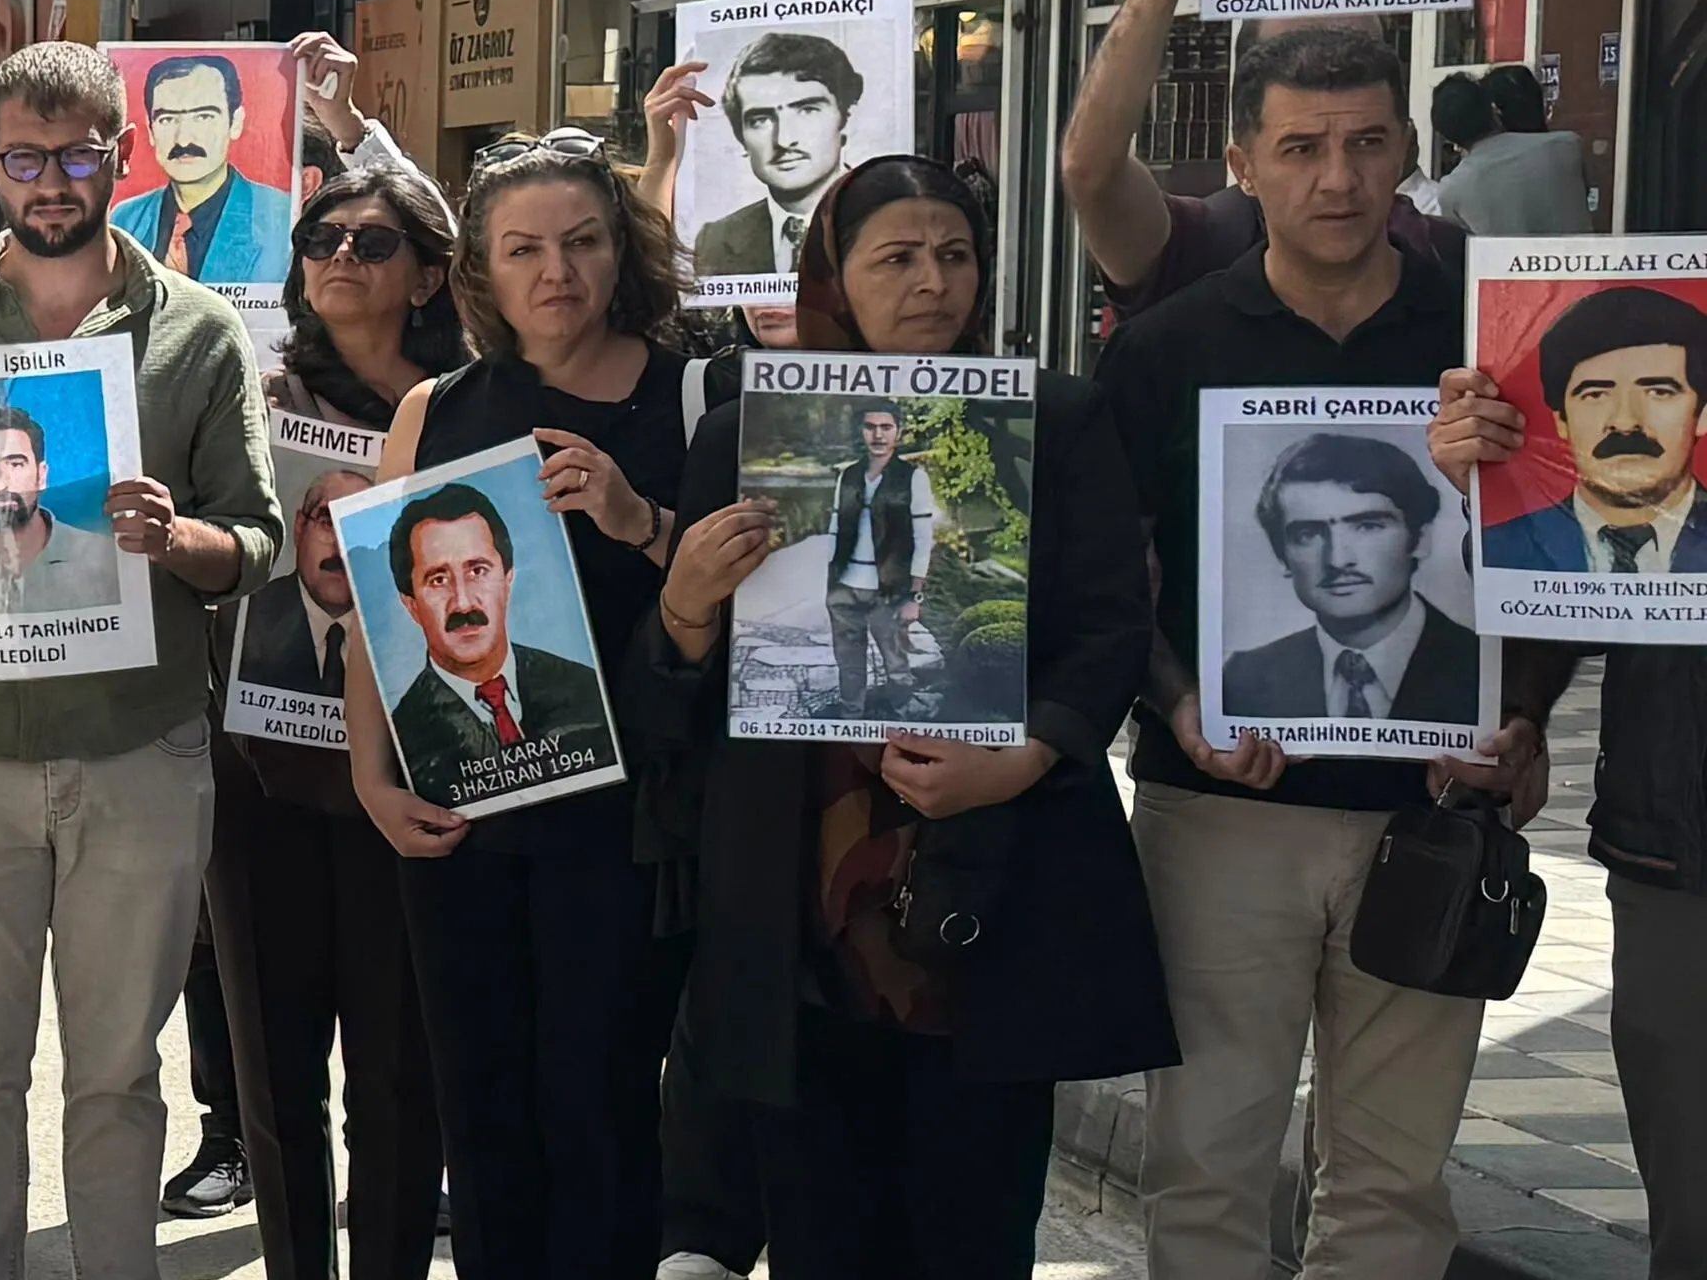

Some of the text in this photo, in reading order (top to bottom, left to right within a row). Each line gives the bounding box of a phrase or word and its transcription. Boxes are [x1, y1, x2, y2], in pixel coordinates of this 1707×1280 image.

[709, 1, 768, 23] SABRİ
[1603, 46, 1617, 62] 15
[1507, 252, 1707, 274] ABDULLAH CA
[230, 296, 286, 311] ATLEDİLD
[3, 351, 67, 375] İŞBİLİR
[752, 358, 1030, 398] ROJHAT ÖZDEL
[1241, 395, 1317, 416] SABRİ
[279, 416, 375, 458] MEHMET
[1500, 599, 1634, 621] GÖZALTINDA
[17, 614, 121, 639] TARİHİNDE
[239, 688, 346, 721] 11.07.1994 TA
[263, 717, 347, 744] KATLEDİLD
[739, 721, 826, 737] 06.12.2014
[1275, 723, 1373, 743] TARİHİNDE
[1376, 724, 1475, 750] KATLEDİLDİ
[458, 733, 563, 779] Hacı KARAY
[449, 746, 597, 803] 3 HAZİRAN 1994
